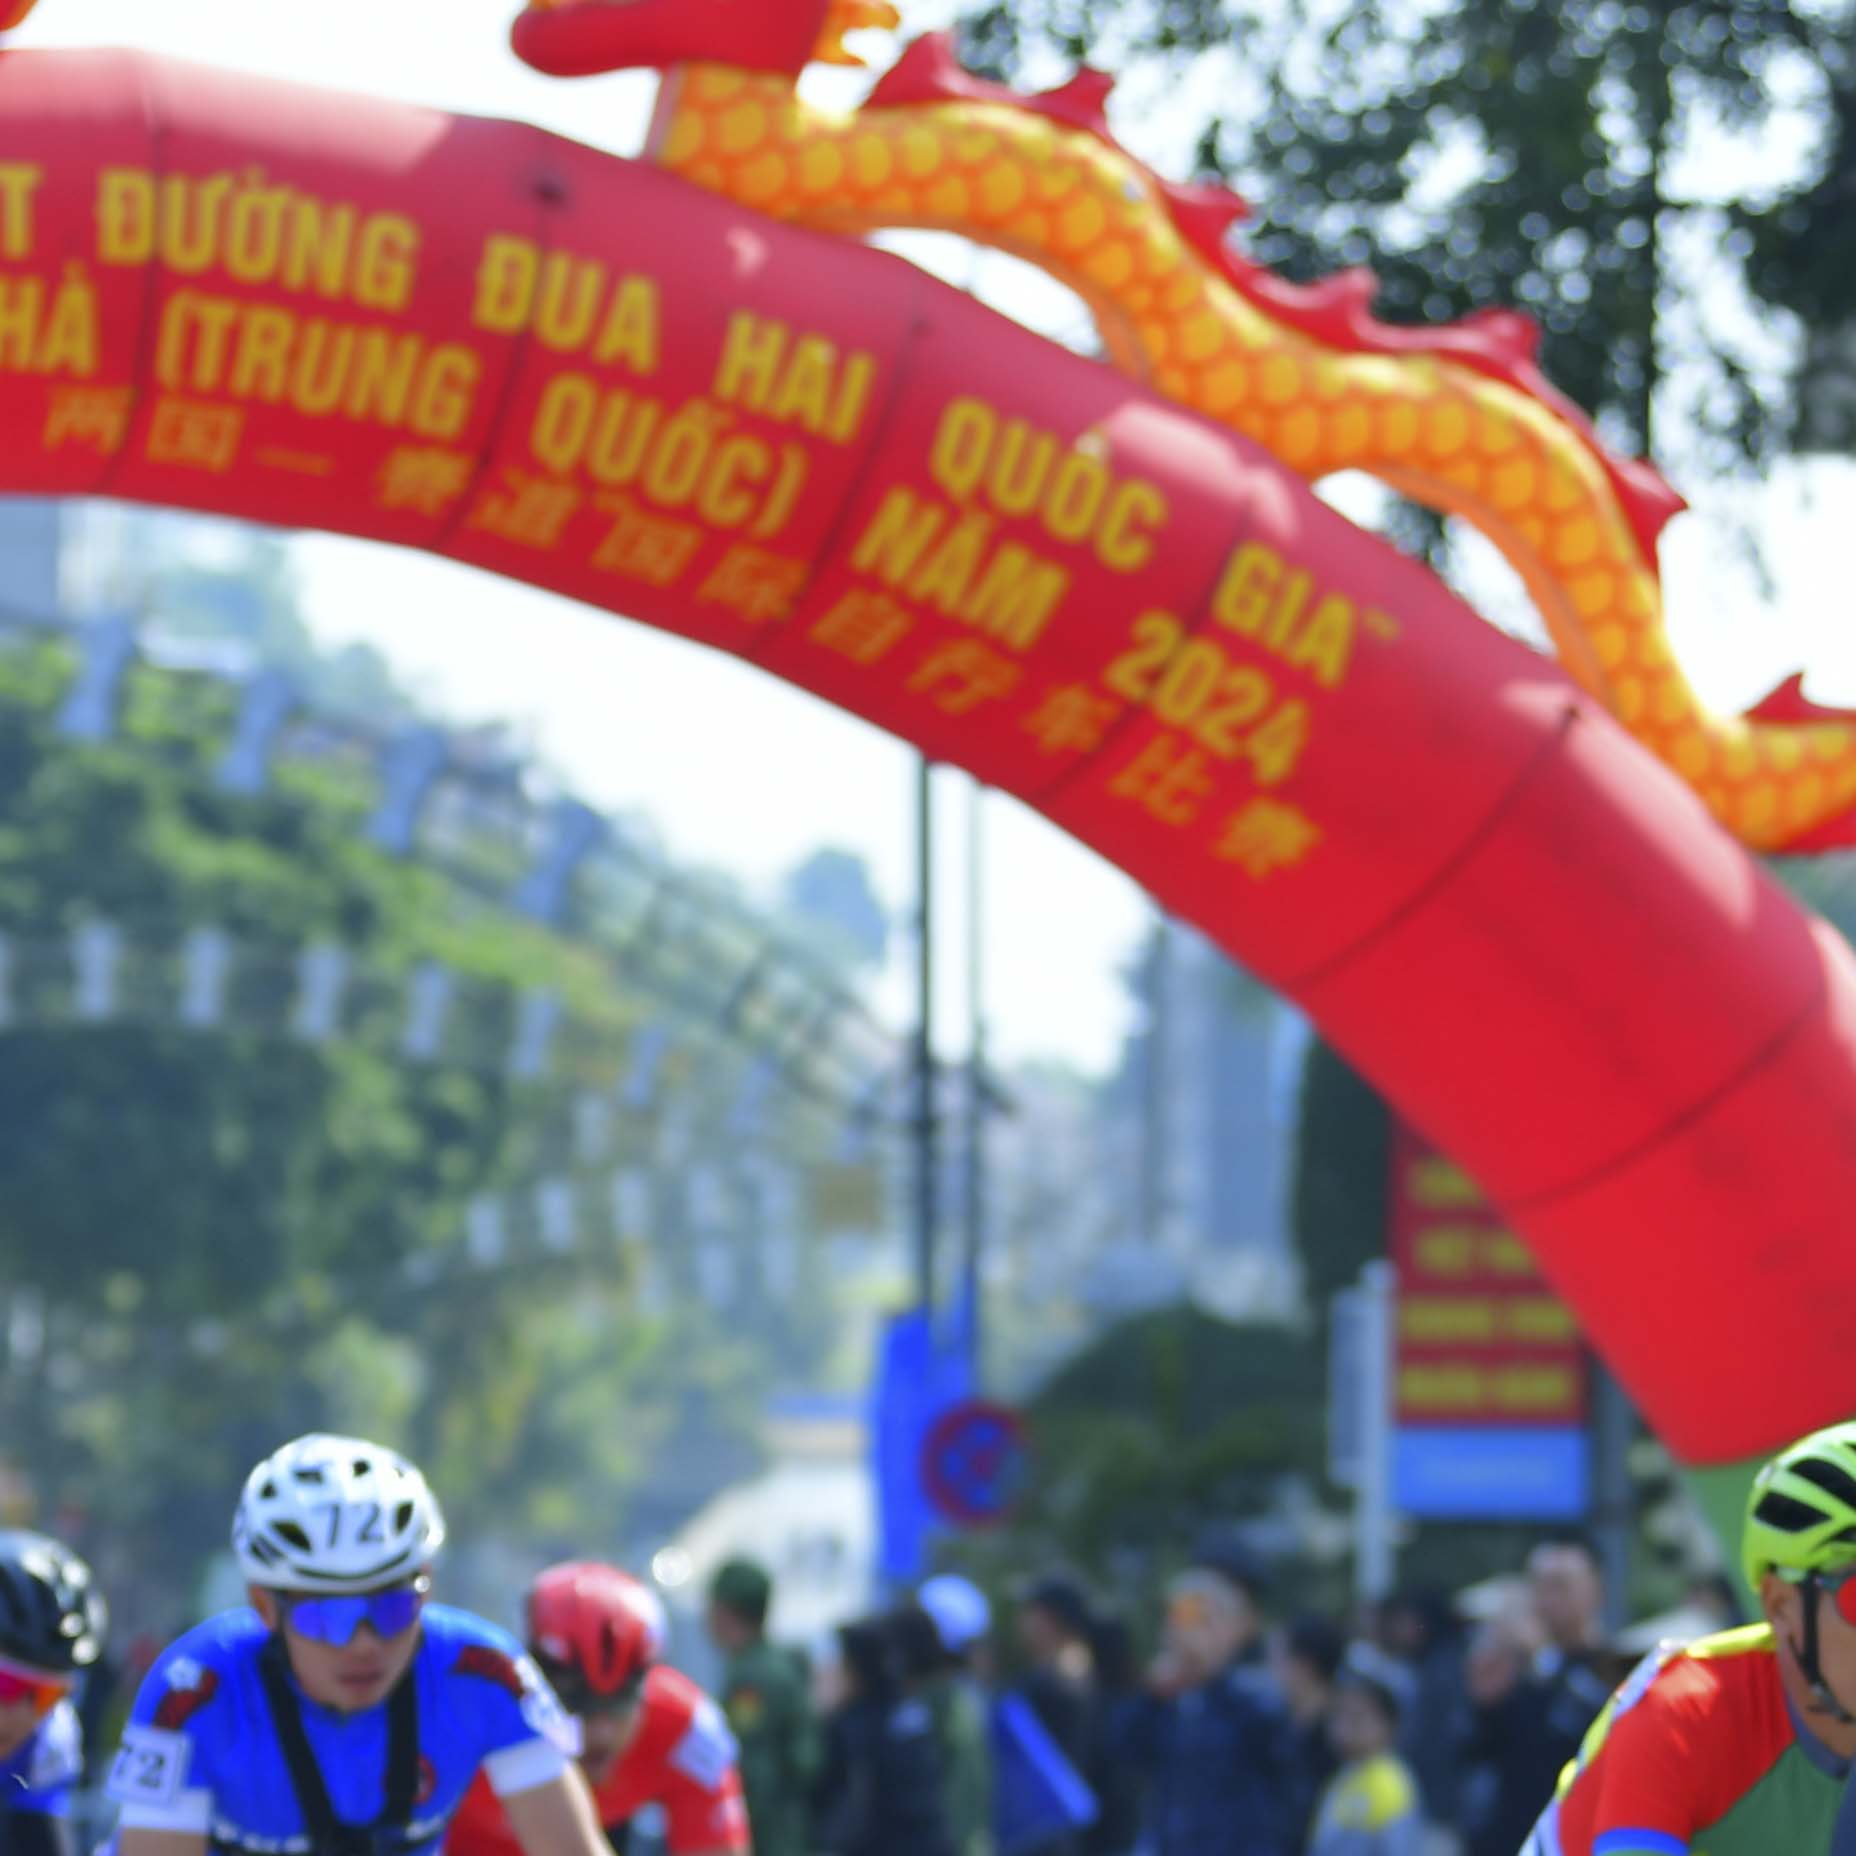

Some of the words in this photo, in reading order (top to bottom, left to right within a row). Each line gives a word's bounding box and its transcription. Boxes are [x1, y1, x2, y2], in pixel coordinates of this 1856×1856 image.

[97, 164, 419, 312] ĐƯỜNG
[473, 231, 660, 376] ĐUA
[713, 310, 878, 447] HAI
[154, 288, 480, 440] (TRUNG
[531, 395, 810, 542] QUỐC)
[850, 484, 1072, 656] NĂM
[1101, 608, 1308, 787] 2024
[313, 1502, 386, 1549] 72
